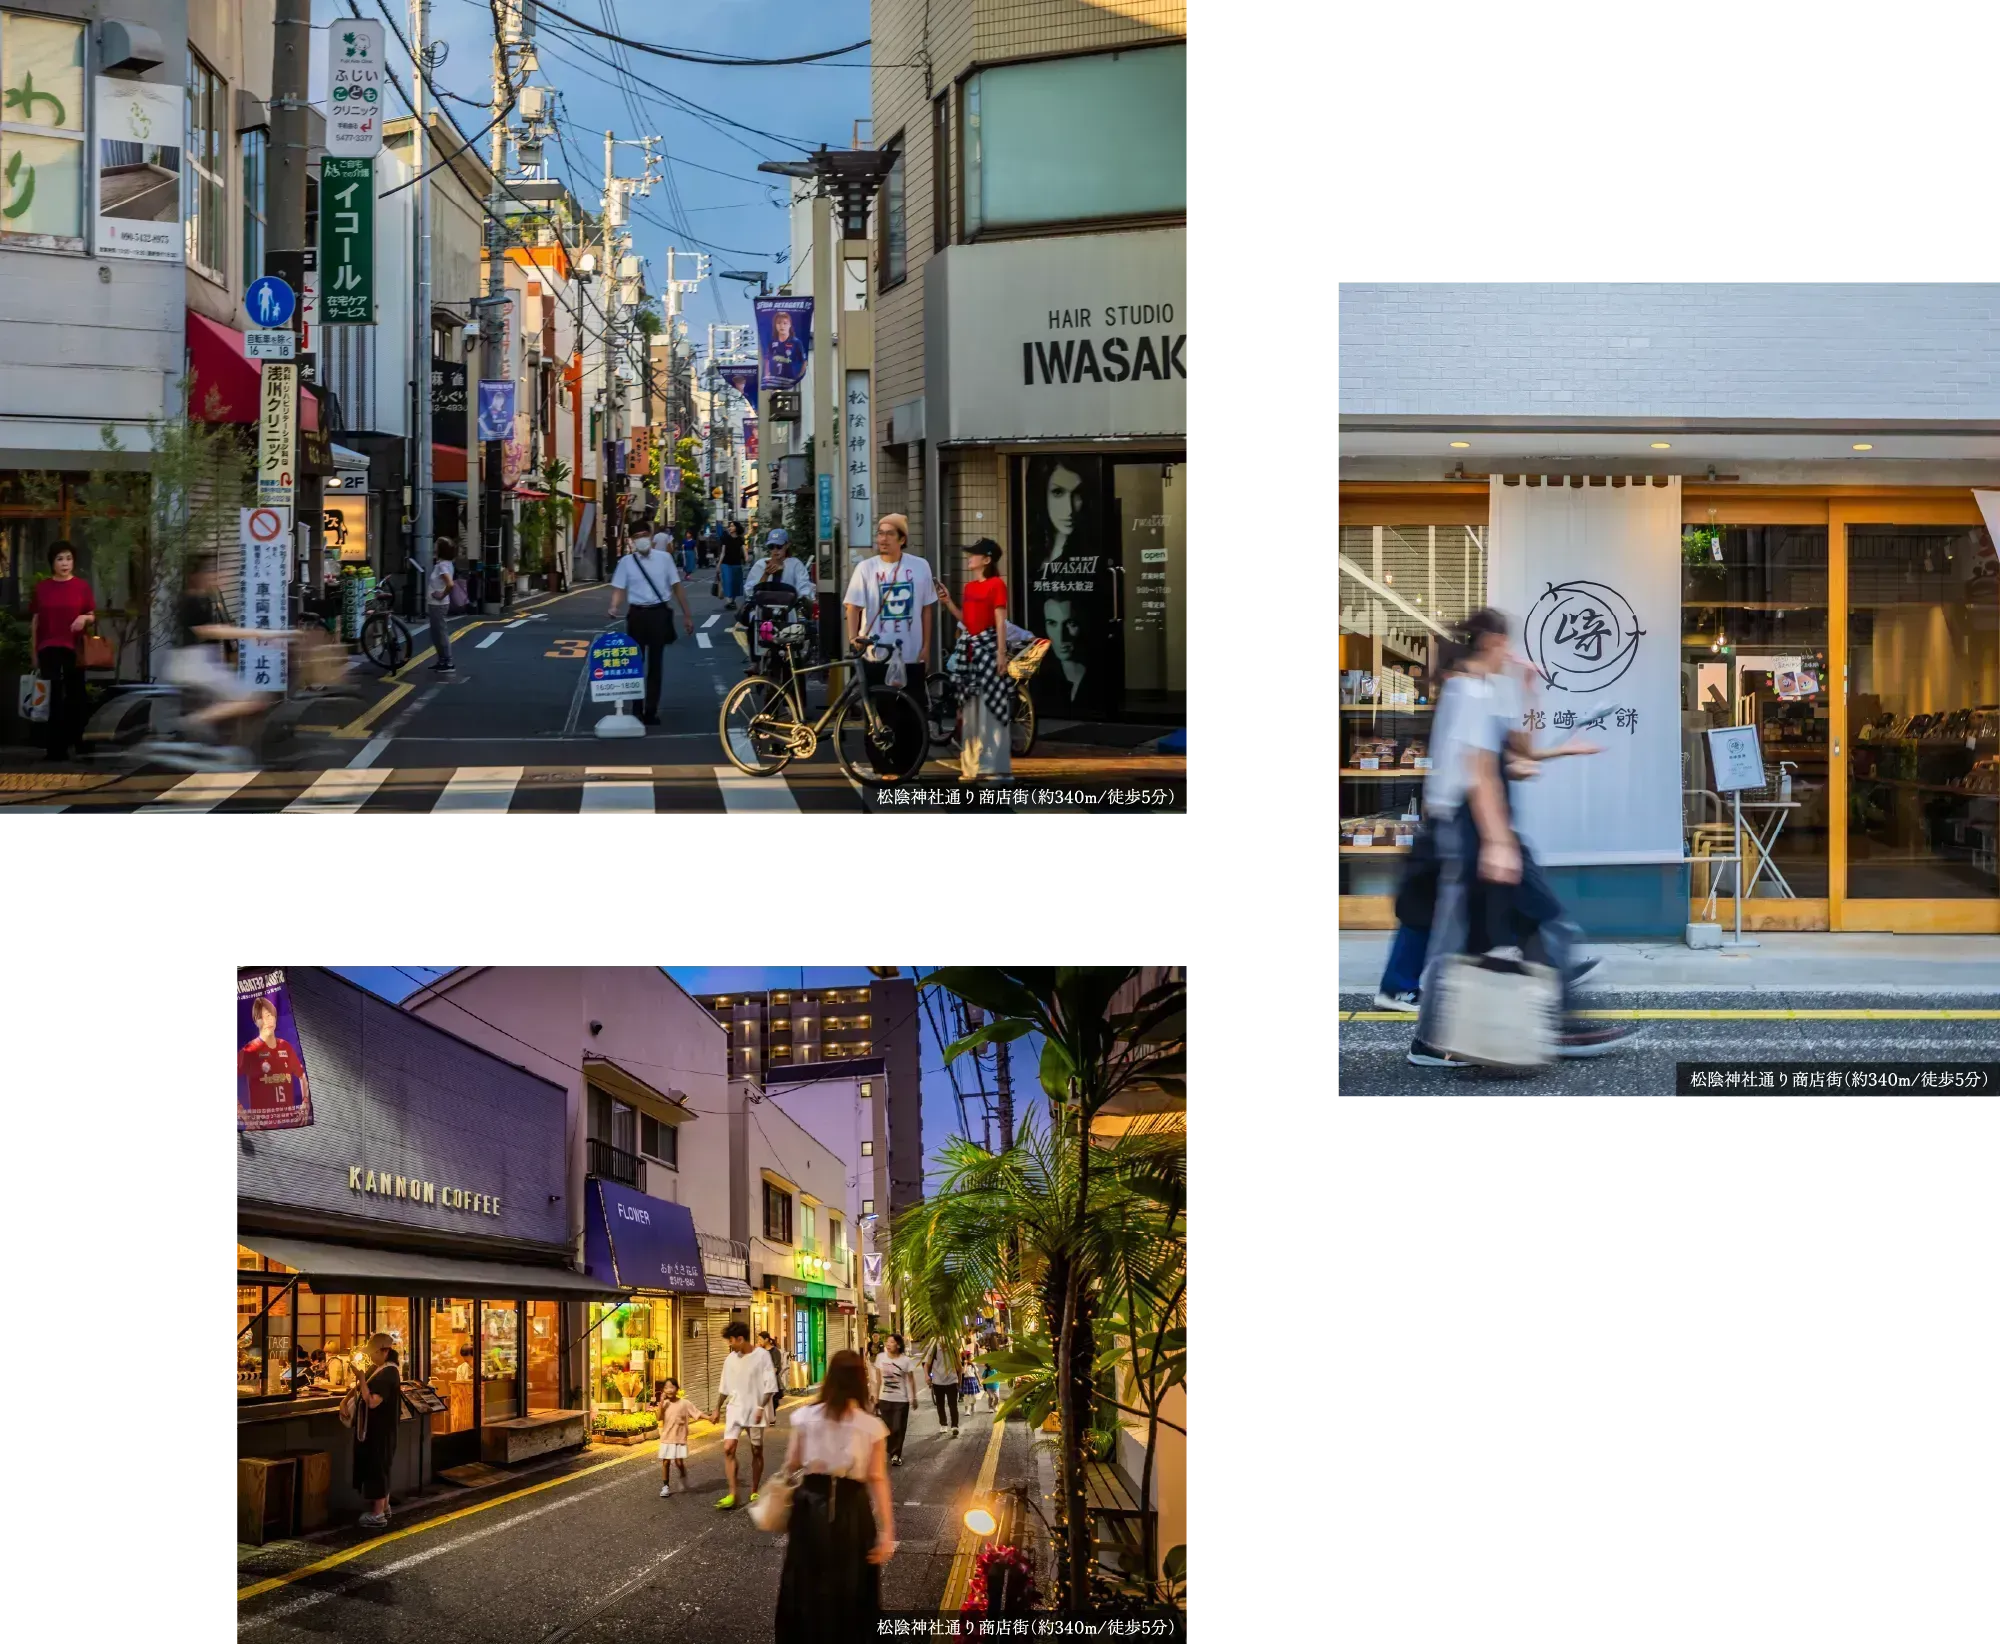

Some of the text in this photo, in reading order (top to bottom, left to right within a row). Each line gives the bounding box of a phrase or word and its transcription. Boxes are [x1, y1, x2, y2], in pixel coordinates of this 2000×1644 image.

[335, 69, 378, 82] ふじい
[334, 86, 377, 102] こども
[332, 105, 378, 116] クリニック
[332, 182, 362, 291] イコール
[327, 295, 367, 307] 在宅ケア
[328, 307, 367, 318] サービス
[1049, 303, 1174, 329] HAIR STUDIO
[247, 334, 292, 345] 自転車を除く
[250, 346, 259, 356] 16
[279, 347, 289, 356] 18
[431, 371, 464, 386] 麻雀
[266, 365, 282, 471] 浅川クリニック
[848, 390, 870, 528] 松陰神社通り
[344, 477, 364, 489] 2F
[1144, 551, 1165, 560] open
[1041, 556, 1099, 579] IWASAKI
[1033, 581, 1094, 591] 男性客も大歓迎
[255, 582, 271, 685] 車両通止め
[593, 647, 638, 658] 歩行者天国
[602, 658, 630, 668] 実施中
[350, 1165, 500, 1216] KANNON COFFEE
[617, 1202, 651, 1225] FLOWER
[267, 1336, 290, 1349] TAKE
